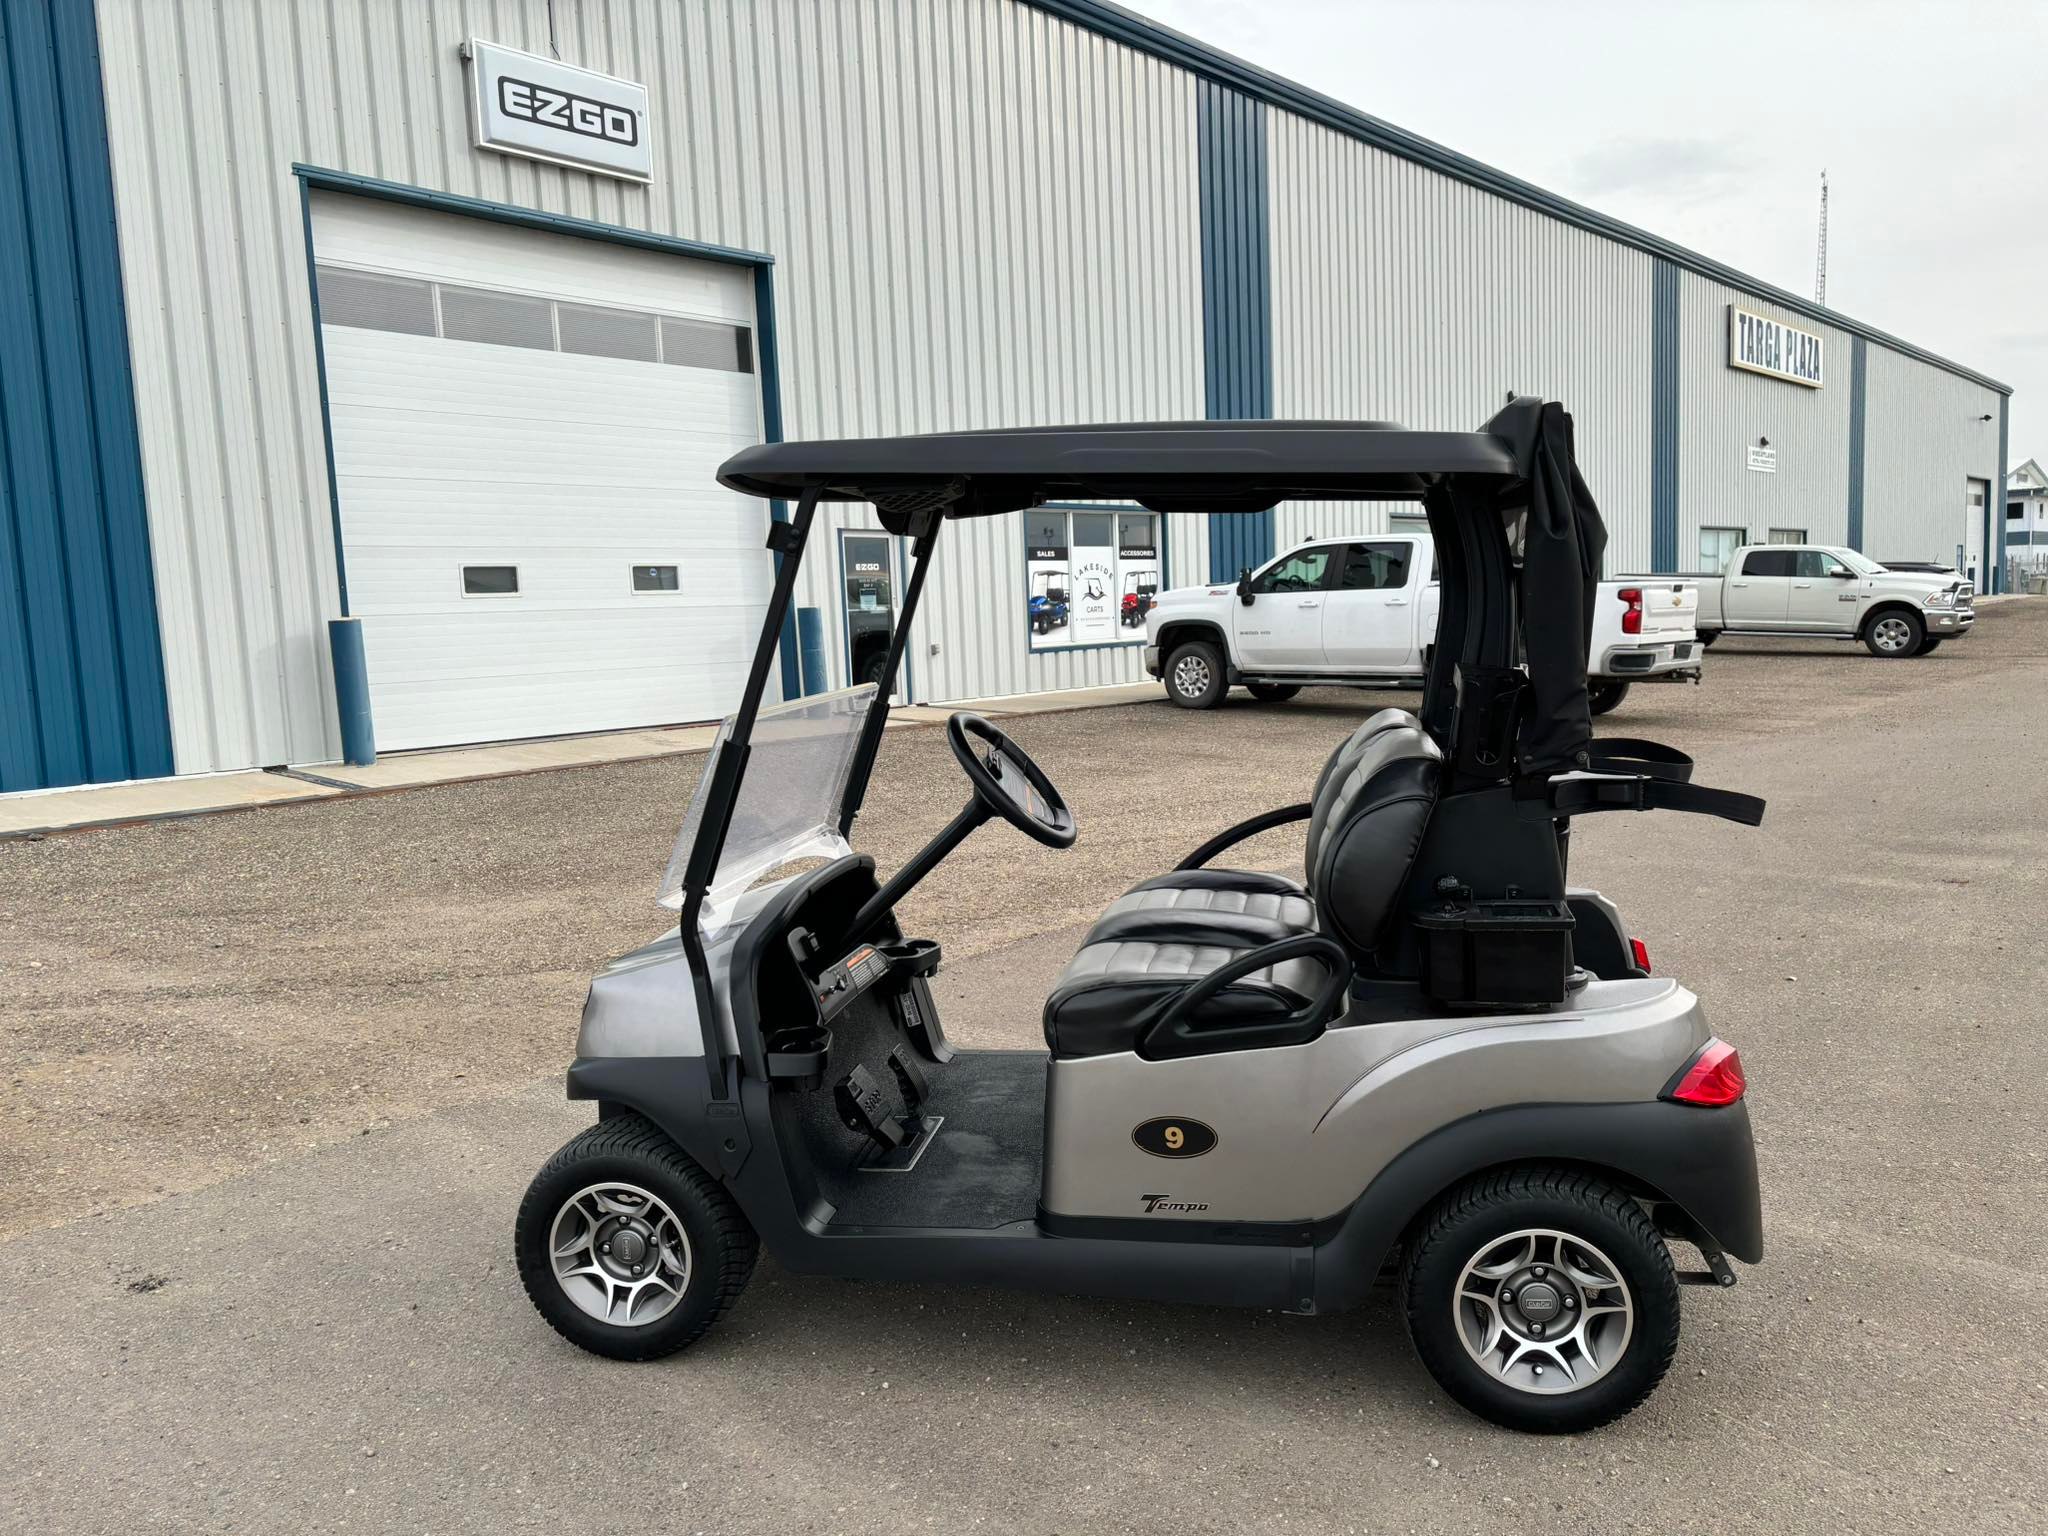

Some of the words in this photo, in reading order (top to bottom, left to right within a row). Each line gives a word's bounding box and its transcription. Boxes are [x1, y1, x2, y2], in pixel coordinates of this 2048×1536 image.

[501, 79, 636, 144] EZGO
[1739, 313, 1781, 371] TARGA
[1786, 329, 1820, 381] PLAZA
[1074, 563, 1114, 581] LAKESIDE
[1164, 1126, 1185, 1149] 9
[1140, 1194, 1209, 1213] Tempo
